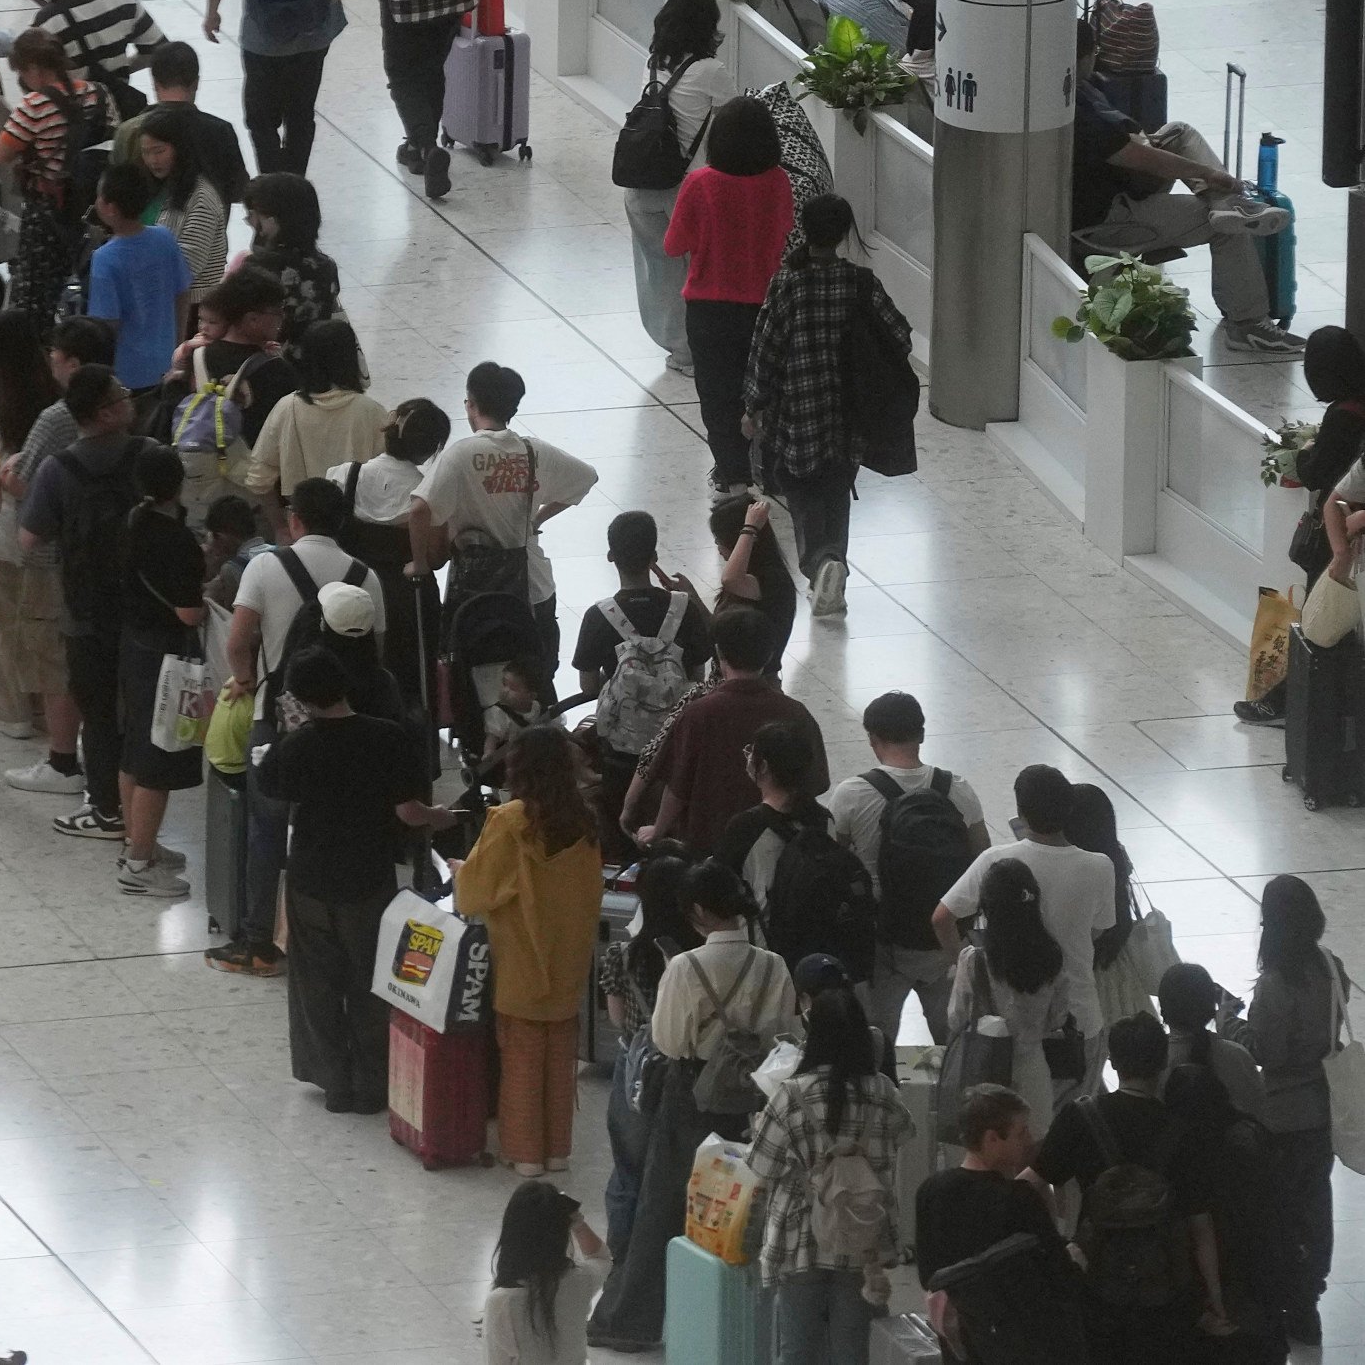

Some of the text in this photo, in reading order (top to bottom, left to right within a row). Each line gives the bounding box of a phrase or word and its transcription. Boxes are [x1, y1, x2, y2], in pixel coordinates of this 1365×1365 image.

[408, 932, 443, 956] SPAM
[458, 941, 490, 1022] SPAM
[387, 982, 421, 1009] OKINAWA
